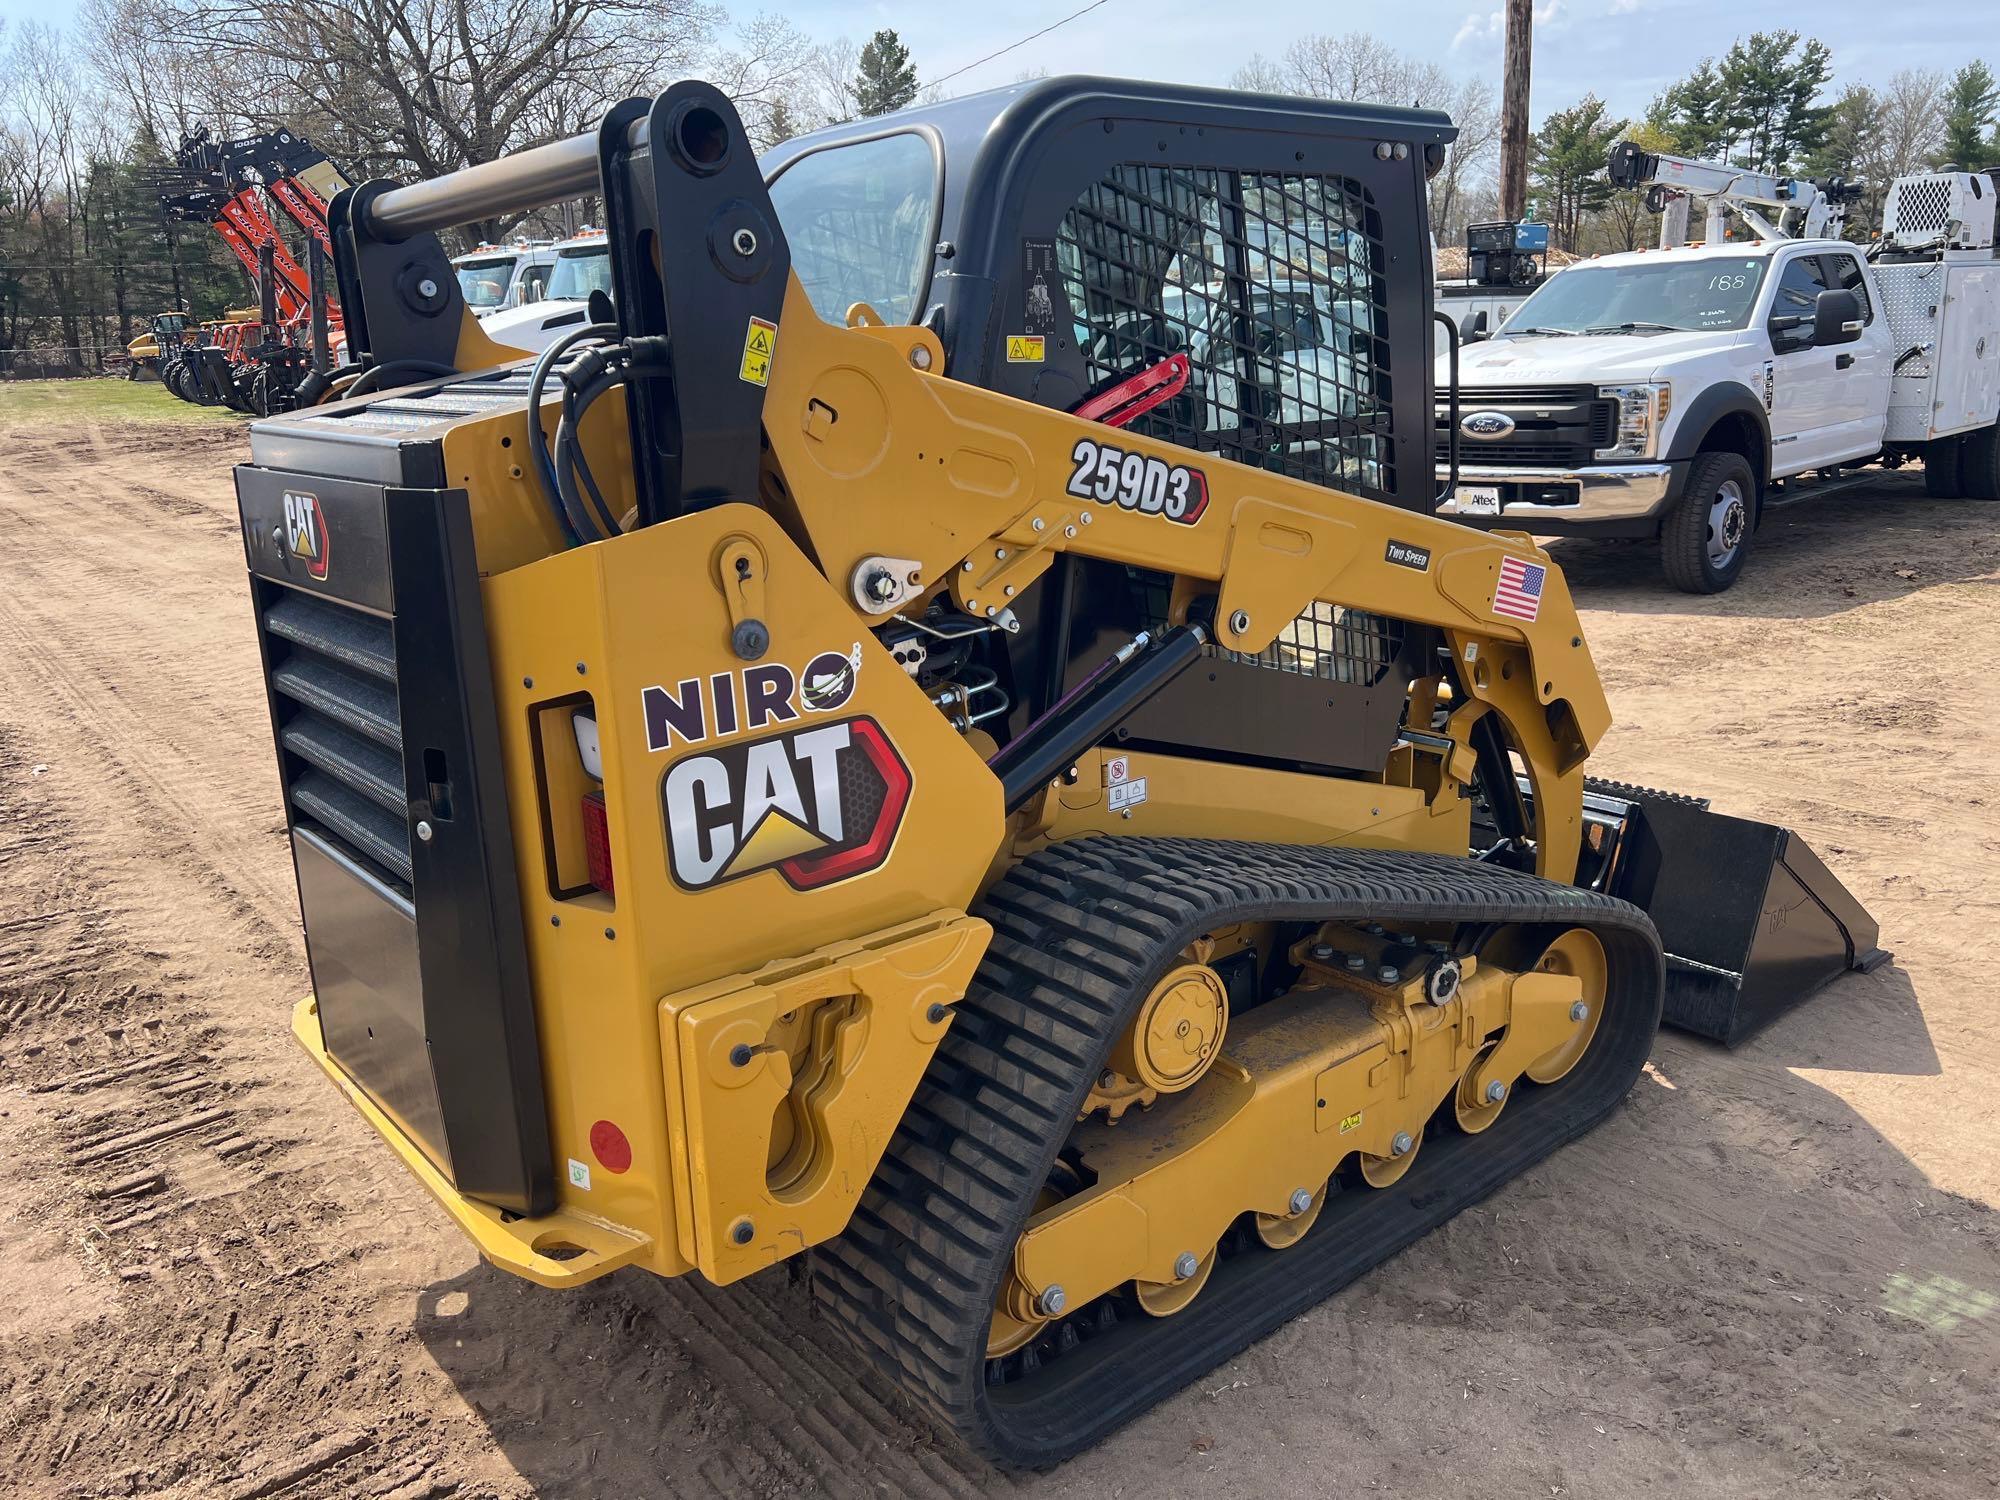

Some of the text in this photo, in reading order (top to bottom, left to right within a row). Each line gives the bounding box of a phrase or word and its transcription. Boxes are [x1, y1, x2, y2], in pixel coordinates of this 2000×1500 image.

[283, 193, 332, 245] SKYTR
[1707, 275, 1746, 291] 188
[1472, 419, 1499, 432] Ford
[1068, 441, 1191, 518] 259D3
[1471, 494, 1497, 506] Altec
[284, 493, 318, 558] CAT
[641, 642, 863, 752] NIRO
[665, 722, 851, 885] CAT
